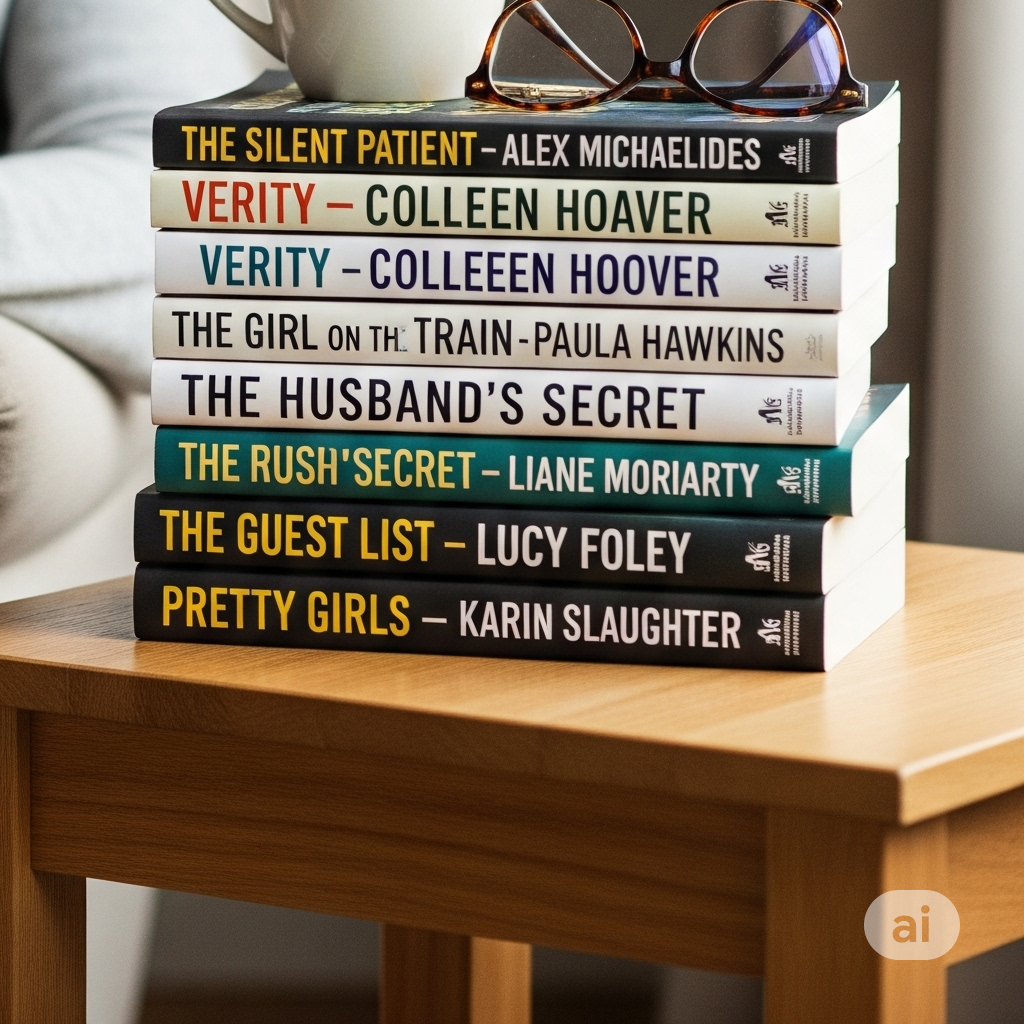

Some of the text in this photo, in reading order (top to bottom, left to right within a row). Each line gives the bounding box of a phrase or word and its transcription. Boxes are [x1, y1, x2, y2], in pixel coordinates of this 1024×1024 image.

[182, 126, 235, 161] THE
[246, 127, 347, 163] SILENT
[358, 129, 477, 165] PATIENT
[502, 134, 570, 166] ALEX
[580, 135, 760, 170] MICHAELIDES
[182, 181, 315, 224] VERITY
[367, 184, 538, 230] COLLEEN
[557, 189, 712, 234] HOAVER
[200, 245, 330, 288] VERITY
[370, 249, 554, 293] COLLEEEN
[571, 254, 719, 297] HOOVER
[172, 311, 232, 347] THE
[245, 313, 318, 350] GIRL
[329, 325, 359, 351] ON
[643, 325, 784, 363] HAWKINS
[181, 375, 260, 417] THE
[281, 377, 523, 425] HUSBAND'S
[543, 384, 705, 430] SECRET
[179, 442, 239, 481] THE
[510, 455, 594, 492] LIANE
[605, 458, 759, 497] MORIARTY
[160, 510, 224, 553] THE
[238, 513, 348, 558] GUEST
[361, 518, 434, 561] LIST
[478, 523, 567, 567] LUCY
[581, 528, 691, 573] FOLEY
[163, 586, 295, 630] PRETTY
[308, 591, 409, 636] GIRLS
[460, 600, 552, 640] KARIN
[563, 604, 740, 648] SLAUGHTER
